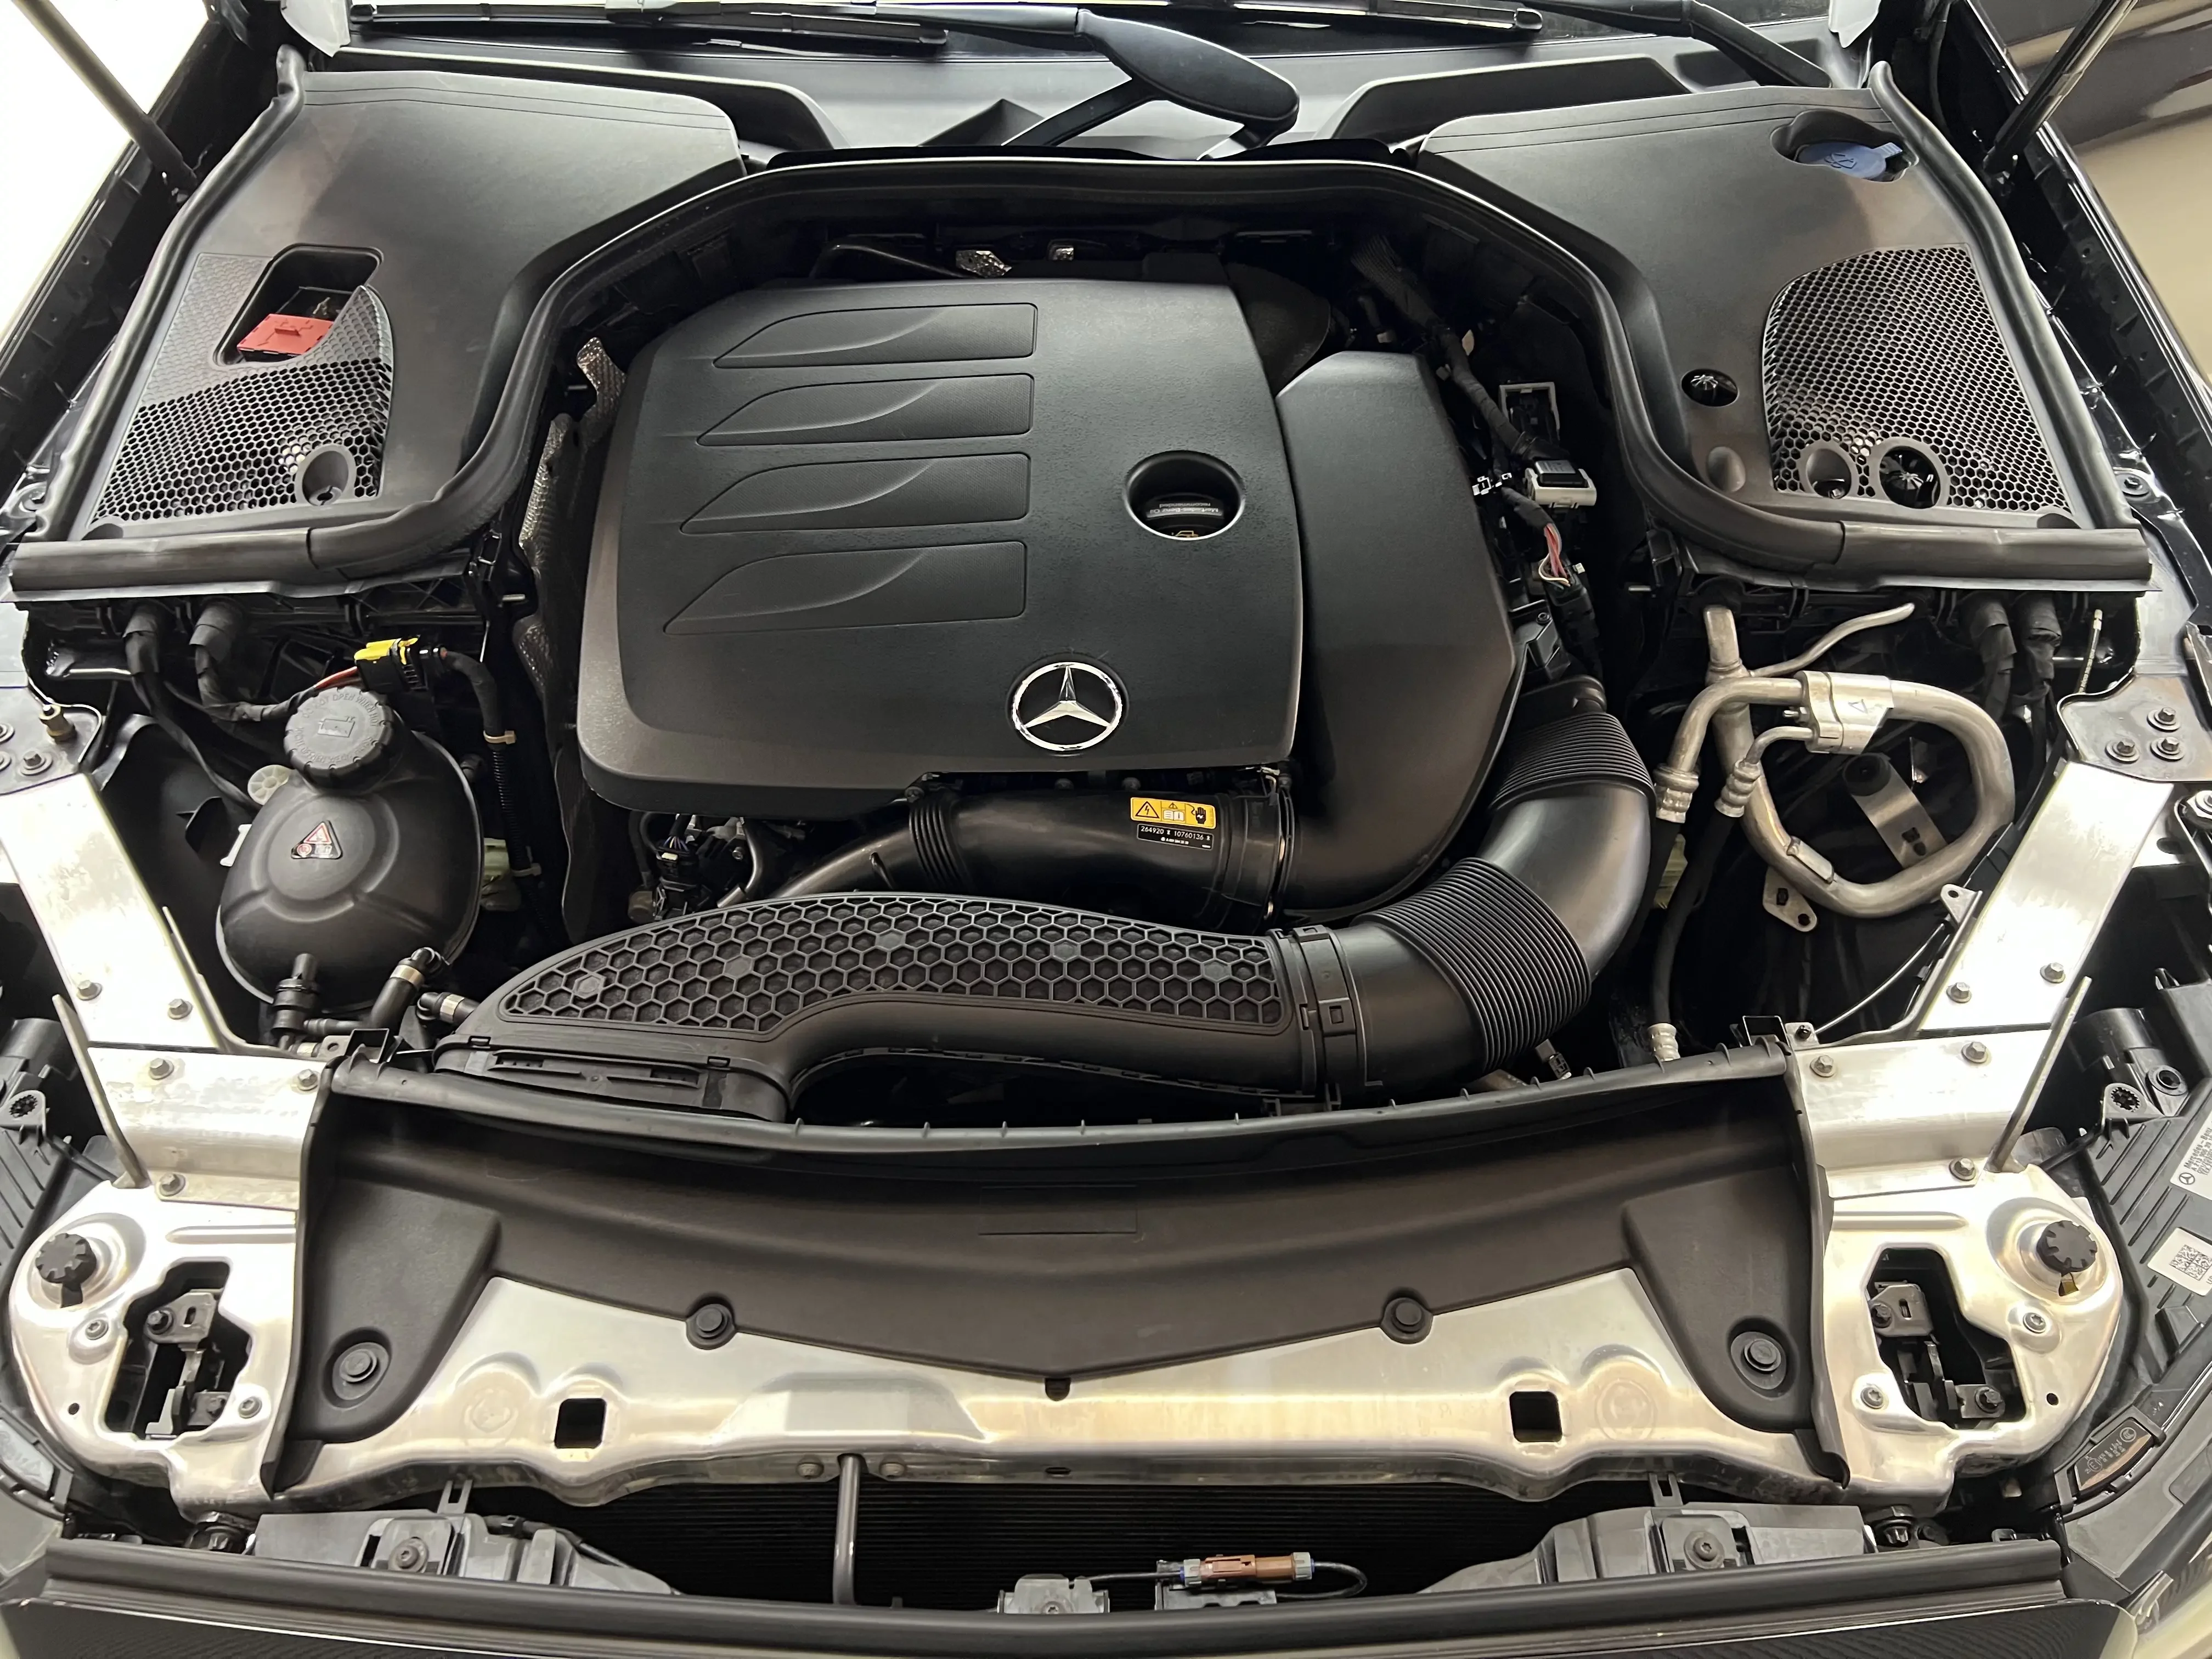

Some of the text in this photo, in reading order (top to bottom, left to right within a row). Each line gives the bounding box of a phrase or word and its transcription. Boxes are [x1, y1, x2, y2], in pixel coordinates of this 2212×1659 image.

[356, 696, 376, 713] WHEN
[369, 713, 380, 727] HOT
[1141, 826, 1204, 840] 264920 10760136
